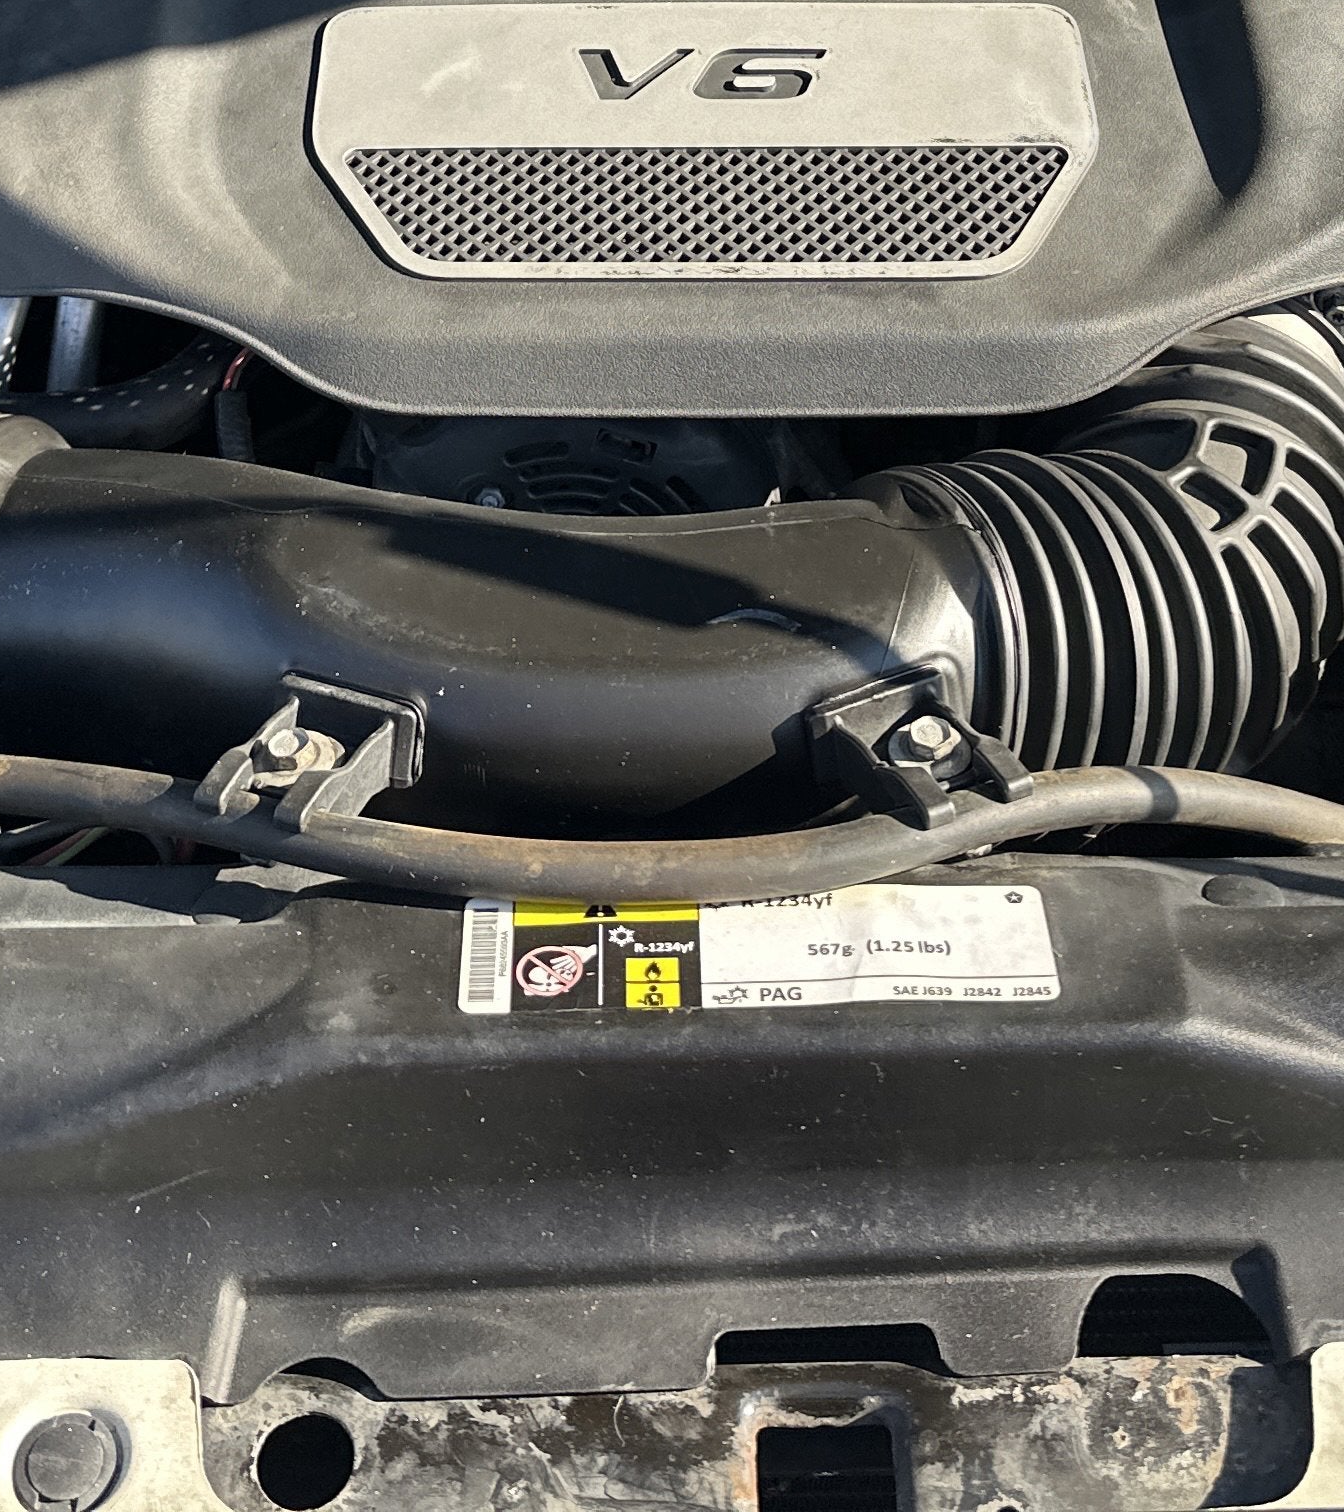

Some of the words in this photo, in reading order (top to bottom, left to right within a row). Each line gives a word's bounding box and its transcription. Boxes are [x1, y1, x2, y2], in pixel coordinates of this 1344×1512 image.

[577, 47, 829, 101] V6
[634, 940, 695, 954] R-1234yf
[807, 942, 853, 957] 567g
[866, 938, 915, 955] (1.25
[918, 939, 952, 956] lbs)
[759, 987, 803, 1002] PAG
[892, 985, 920, 996] SAE
[921, 986, 953, 996] J639
[962, 986, 1003, 997] J2842
[1012, 986, 1052, 997] J2845
